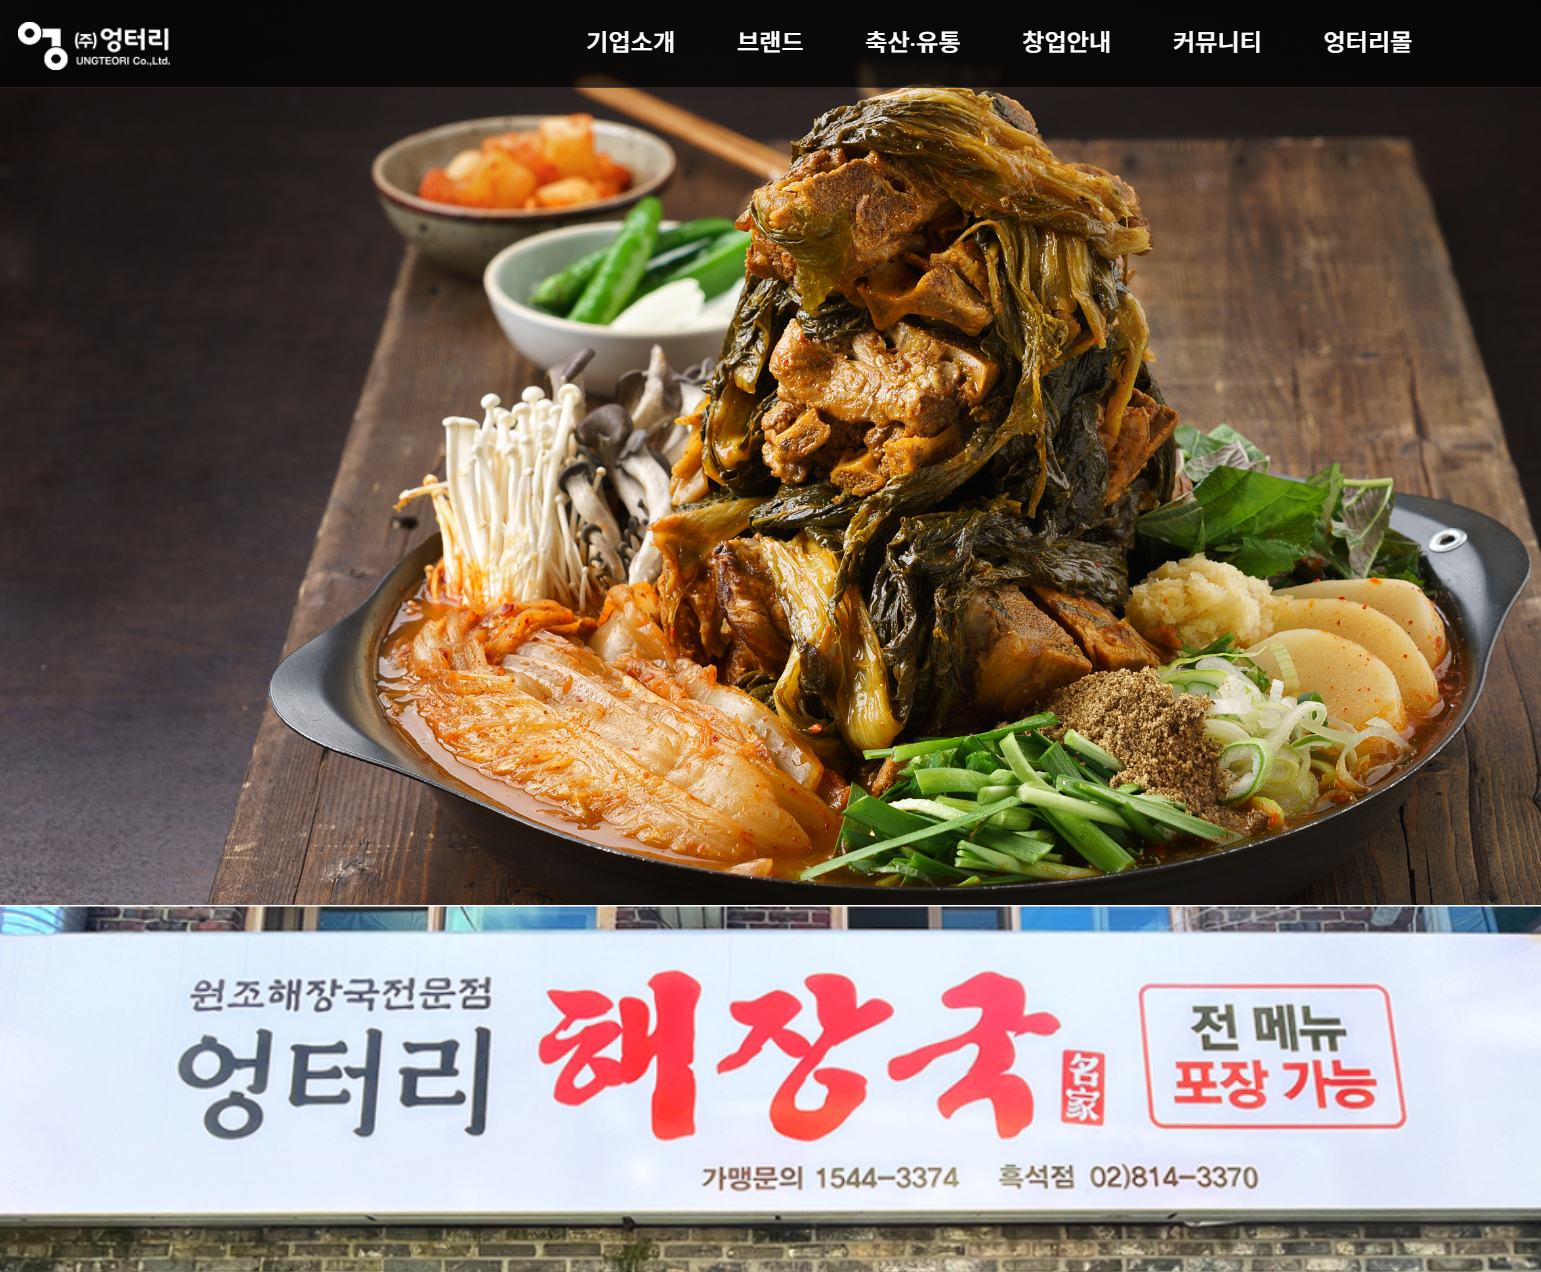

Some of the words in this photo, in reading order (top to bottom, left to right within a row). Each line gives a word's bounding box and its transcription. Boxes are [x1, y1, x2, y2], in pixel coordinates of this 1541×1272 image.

[190, 977, 492, 1012] 원조해장국전문점
[1191, 1004, 1239, 1051] 전
[1253, 1004, 1346, 1051] 메뉴
[539, 970, 1060, 1141] 해장국
[178, 1026, 491, 1139] 엉터리
[1065, 1052, 1101, 1121] 名家
[1174, 1060, 1268, 1109] 포장
[1283, 1059, 1377, 1109] 가능
[702, 1165, 803, 1191] 가맹문의
[816, 1167, 959, 1189] 1544-3374
[998, 1165, 1075, 1190] 흑석점
[1090, 1164, 1259, 1191] 02)814-3370
